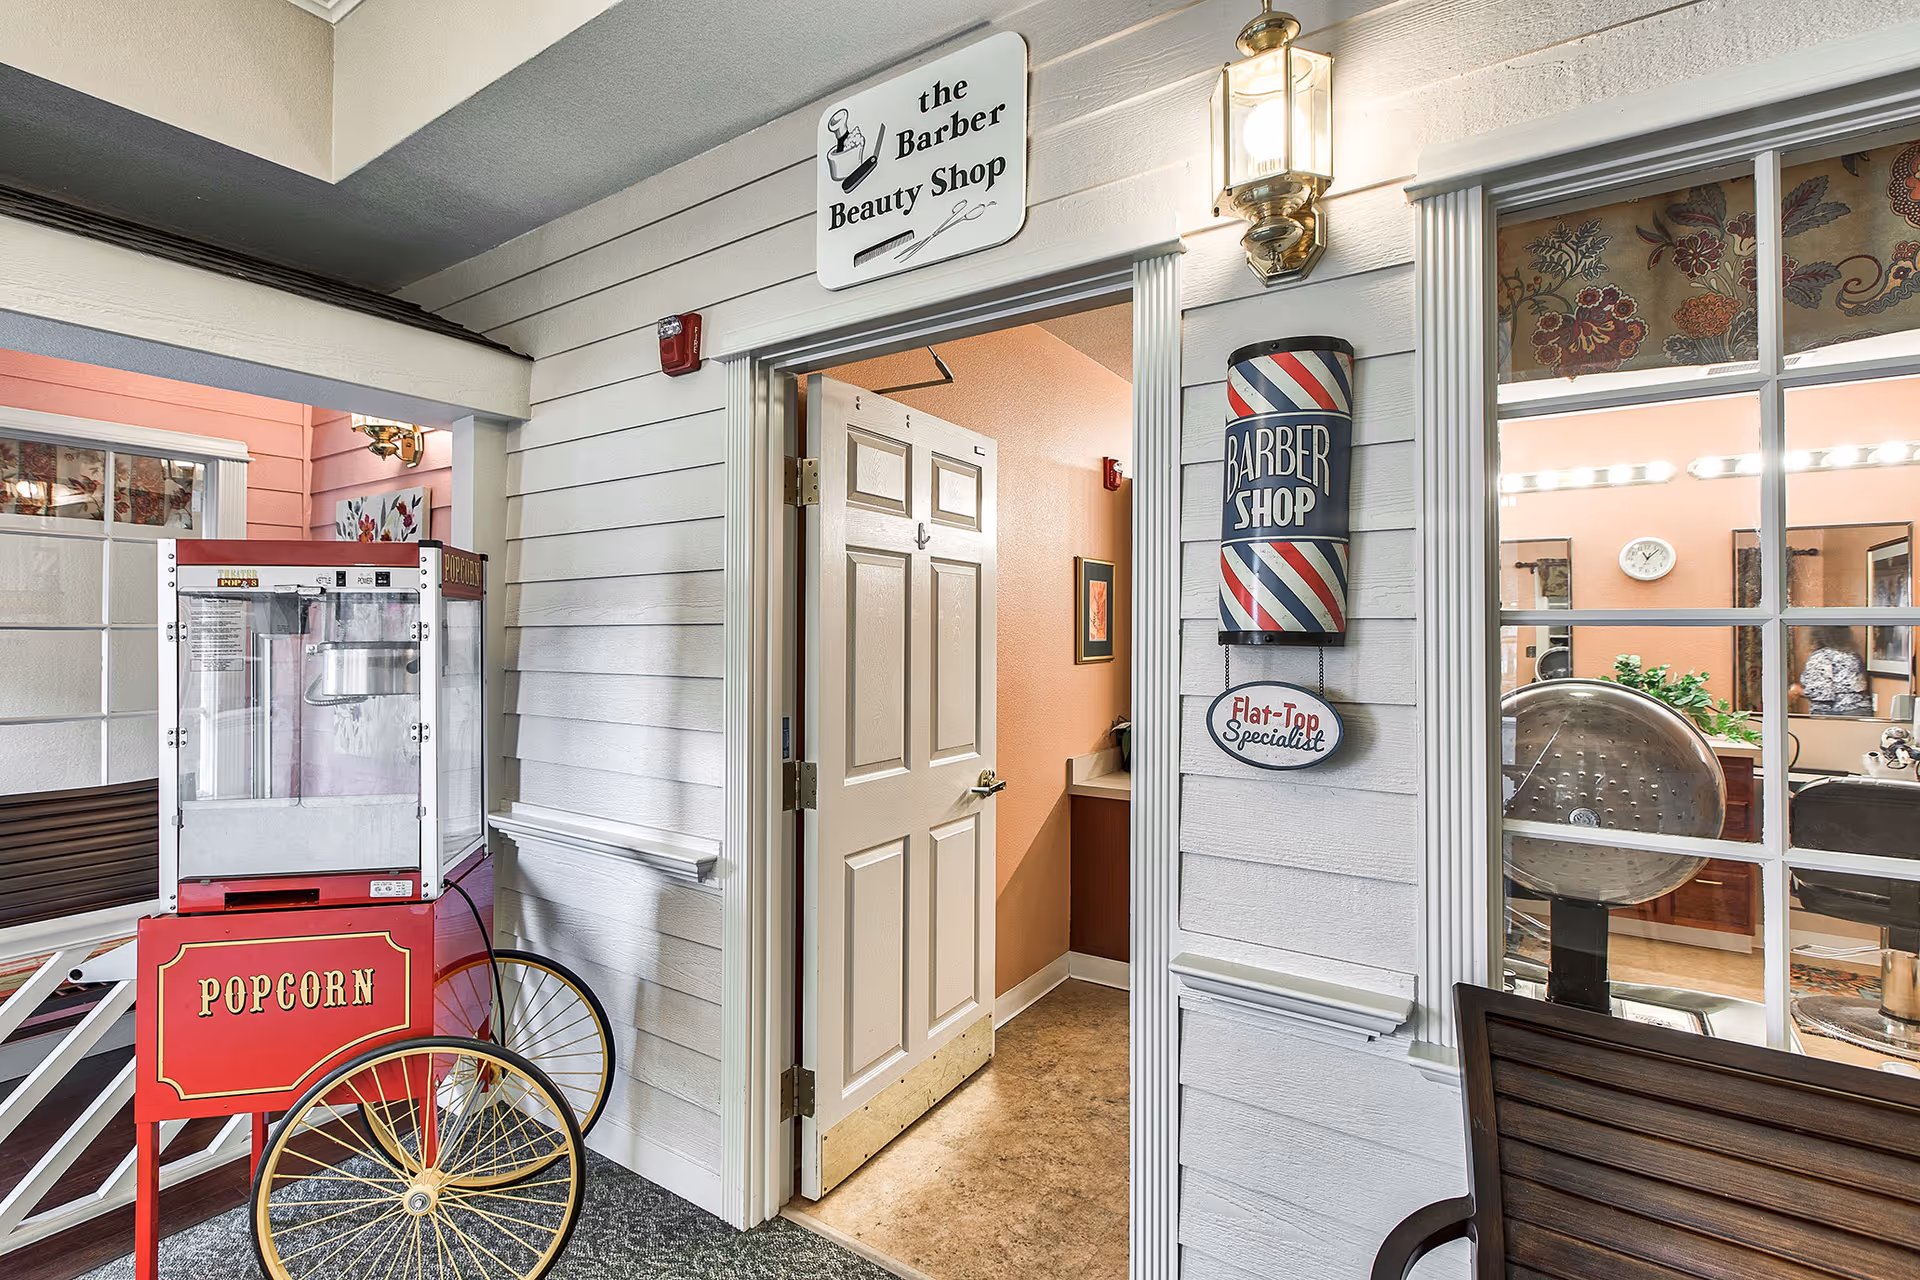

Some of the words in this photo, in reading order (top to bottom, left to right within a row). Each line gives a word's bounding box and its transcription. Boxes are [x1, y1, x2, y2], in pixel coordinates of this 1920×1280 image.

[918, 79, 968, 114] the
[895, 103, 1006, 160] Barber
[828, 183, 924, 231] Beauty
[931, 155, 1007, 198] Shop
[1226, 424, 1331, 503] BARBER
[1234, 486, 1317, 530] SHOP
[217, 569, 258, 578] THEATER
[444, 552, 480, 588] POPCORN
[1222, 719, 1326, 753] Specialist
[1232, 695, 1320, 740] Flat-Top
[198, 968, 375, 1018] POPCORN
